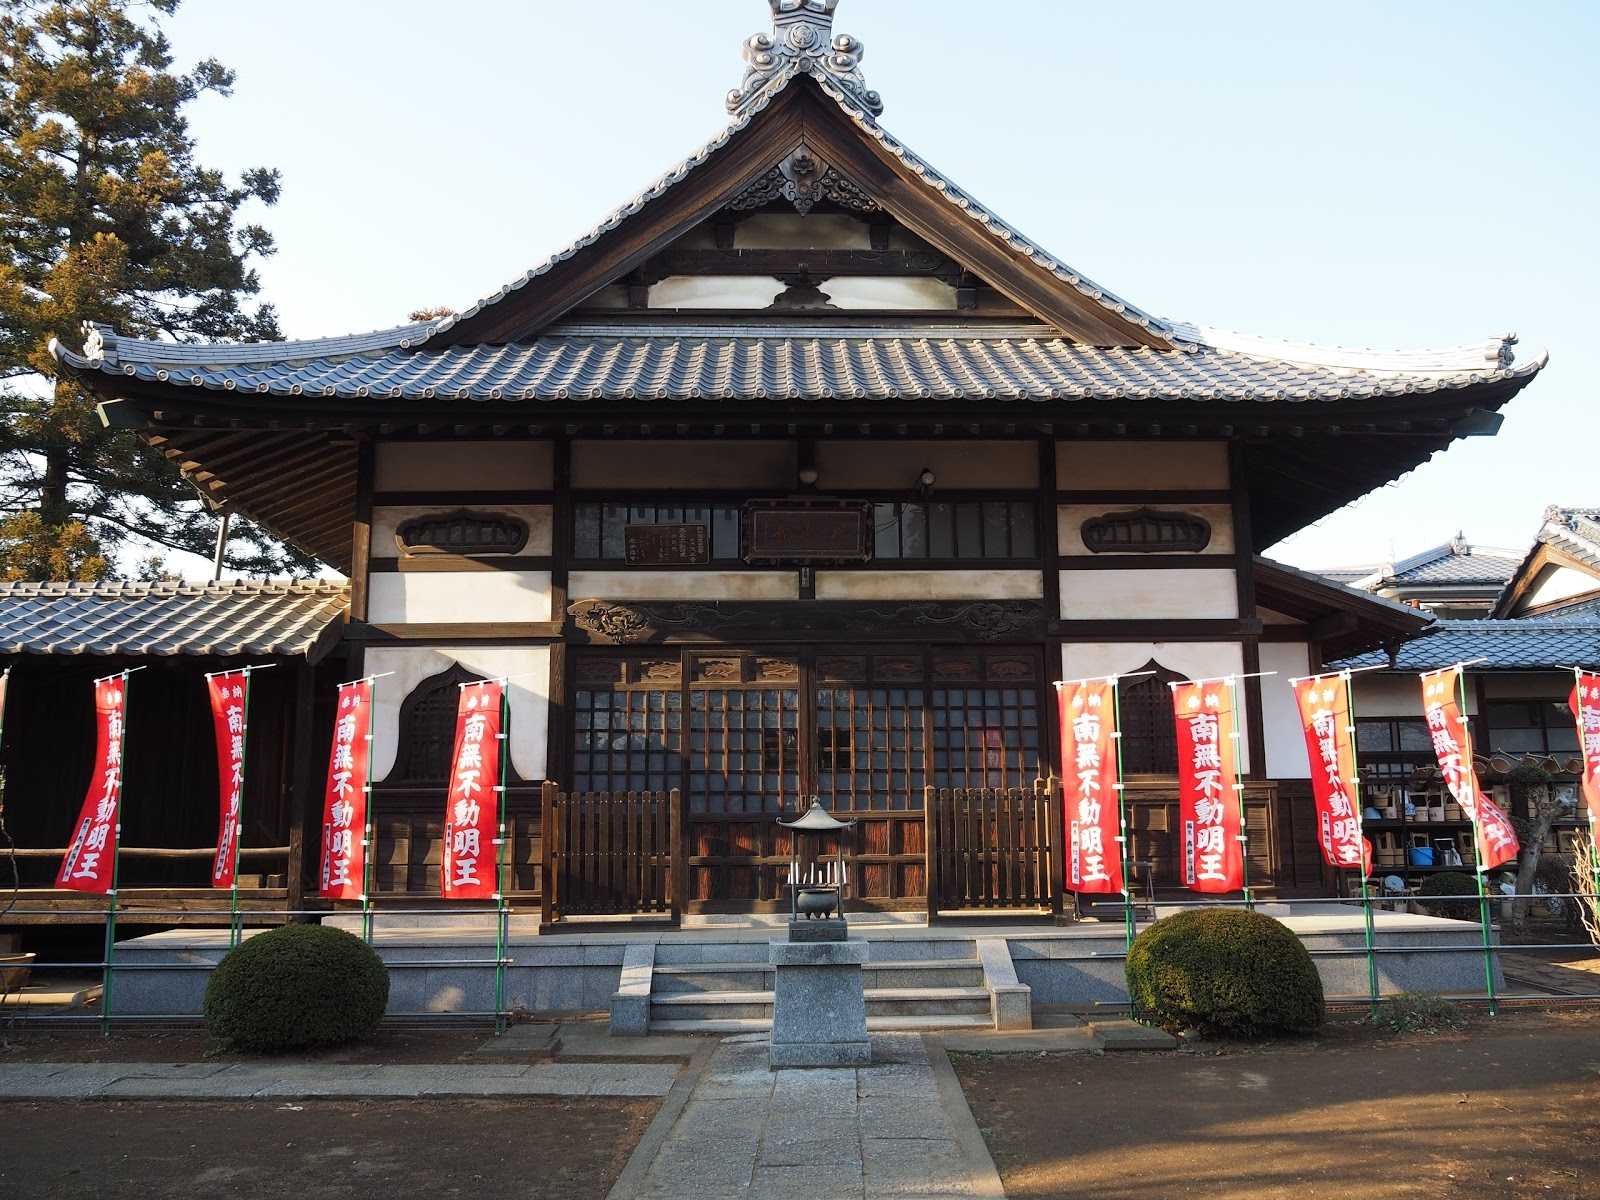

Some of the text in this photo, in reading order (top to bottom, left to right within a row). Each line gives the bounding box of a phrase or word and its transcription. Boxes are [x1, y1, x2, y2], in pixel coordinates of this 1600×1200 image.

[73, 710, 122, 880] 南無不動明王
[330, 715, 357, 887] 南無不動明王
[452, 714, 487, 887] 南無不動明王
[1072, 713, 1110, 881] 南無不動明王
[1189, 713, 1227, 881] 南無不動明王
[1312, 709, 1361, 865] 南無不動明王
